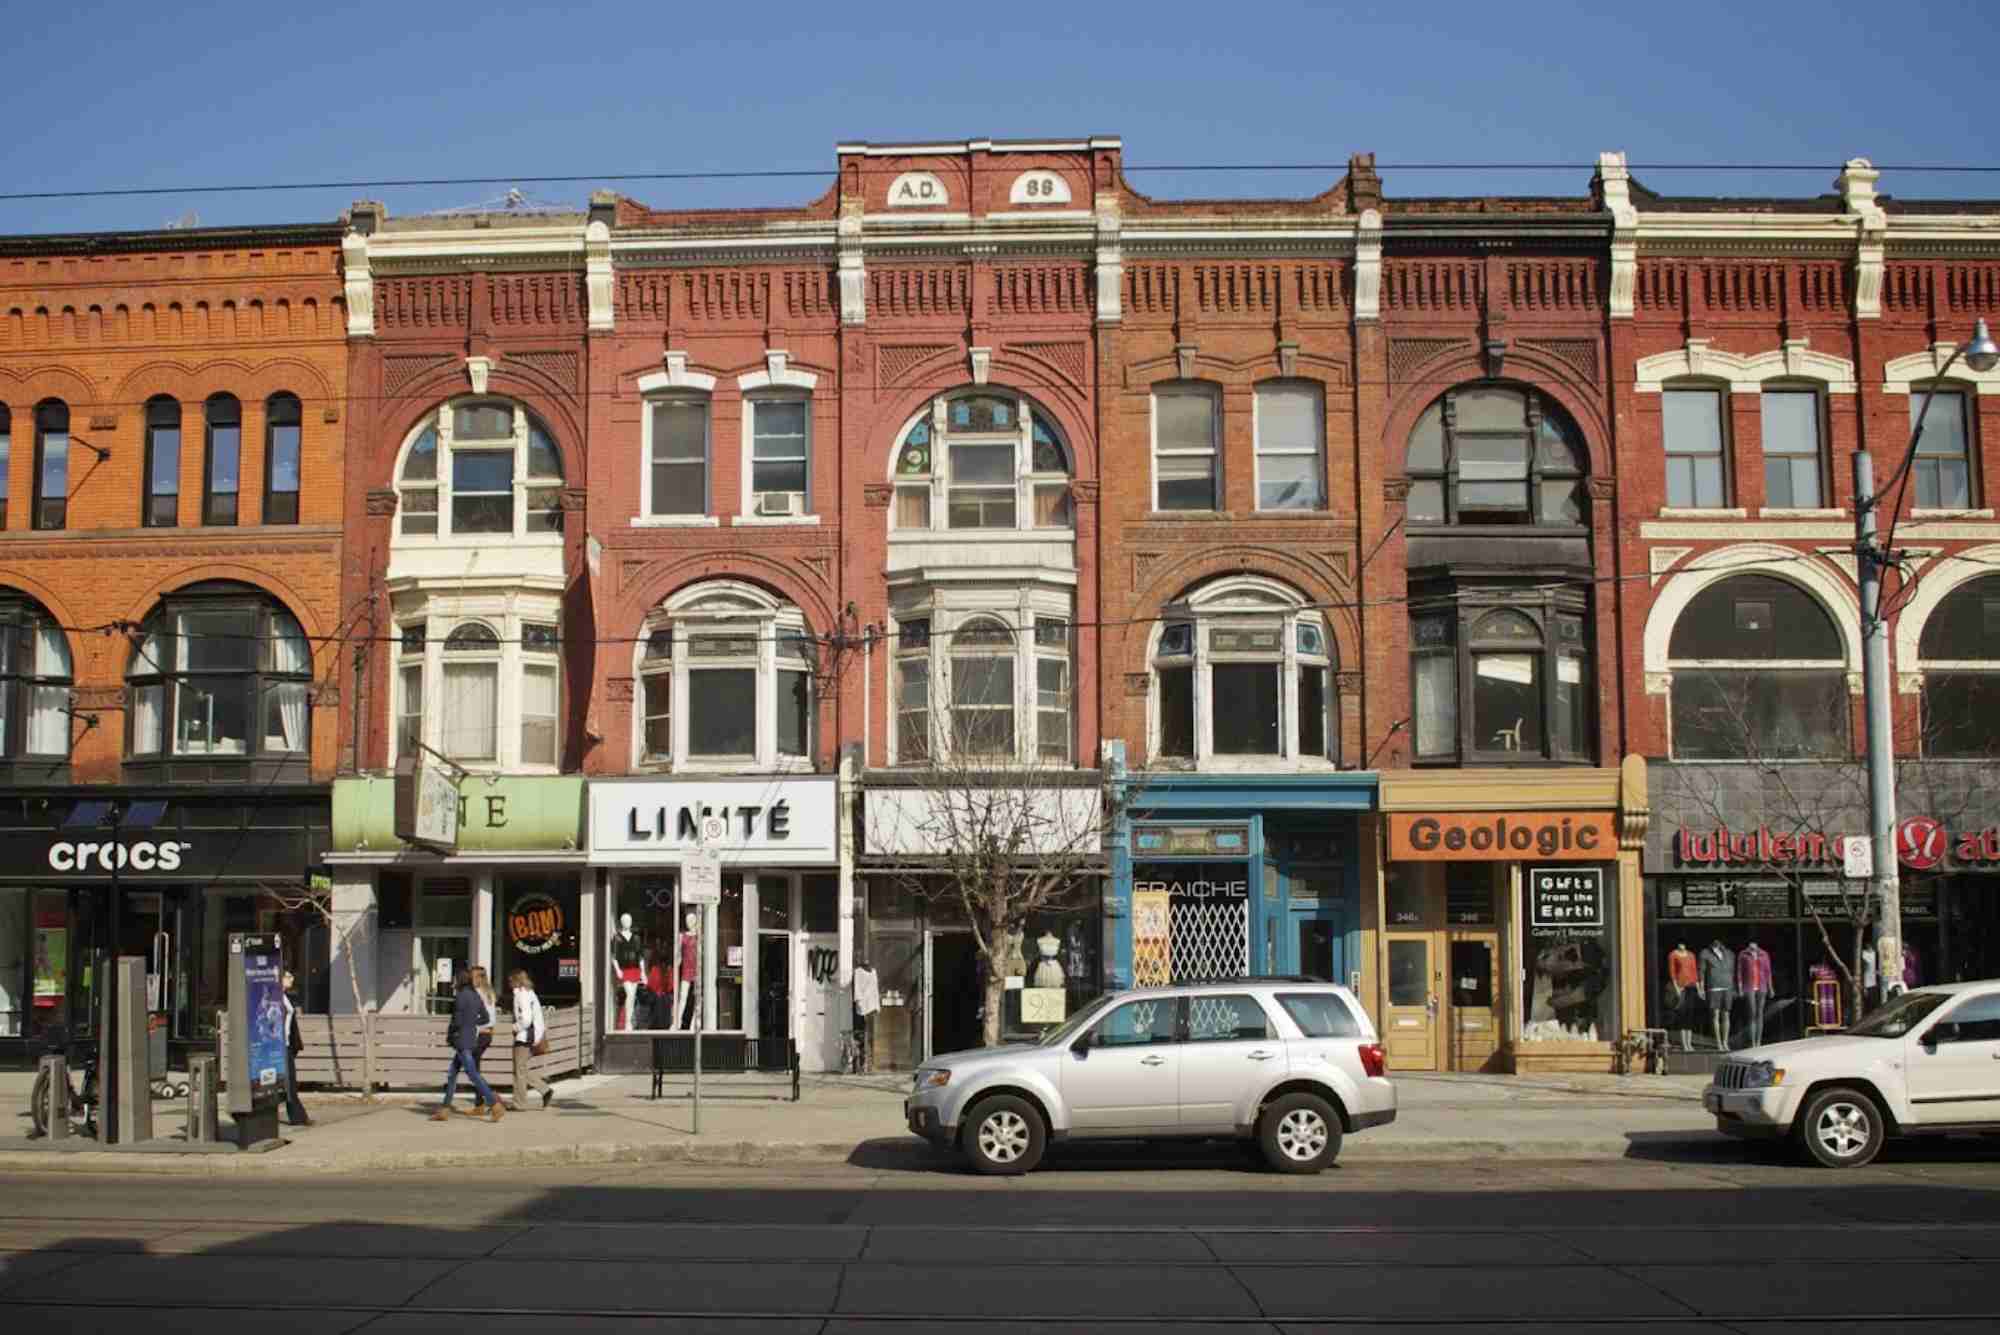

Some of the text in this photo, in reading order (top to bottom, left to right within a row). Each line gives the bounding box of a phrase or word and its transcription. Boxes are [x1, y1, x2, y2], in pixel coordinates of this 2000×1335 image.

[1409, 817, 1600, 856] Geologic
[1678, 823, 1846, 863] lululem
[48, 841, 182, 871] crocs
[1540, 876, 1593, 890] Gifts
[1573, 892, 1594, 902] the
[1540, 904, 1594, 917] Earth
